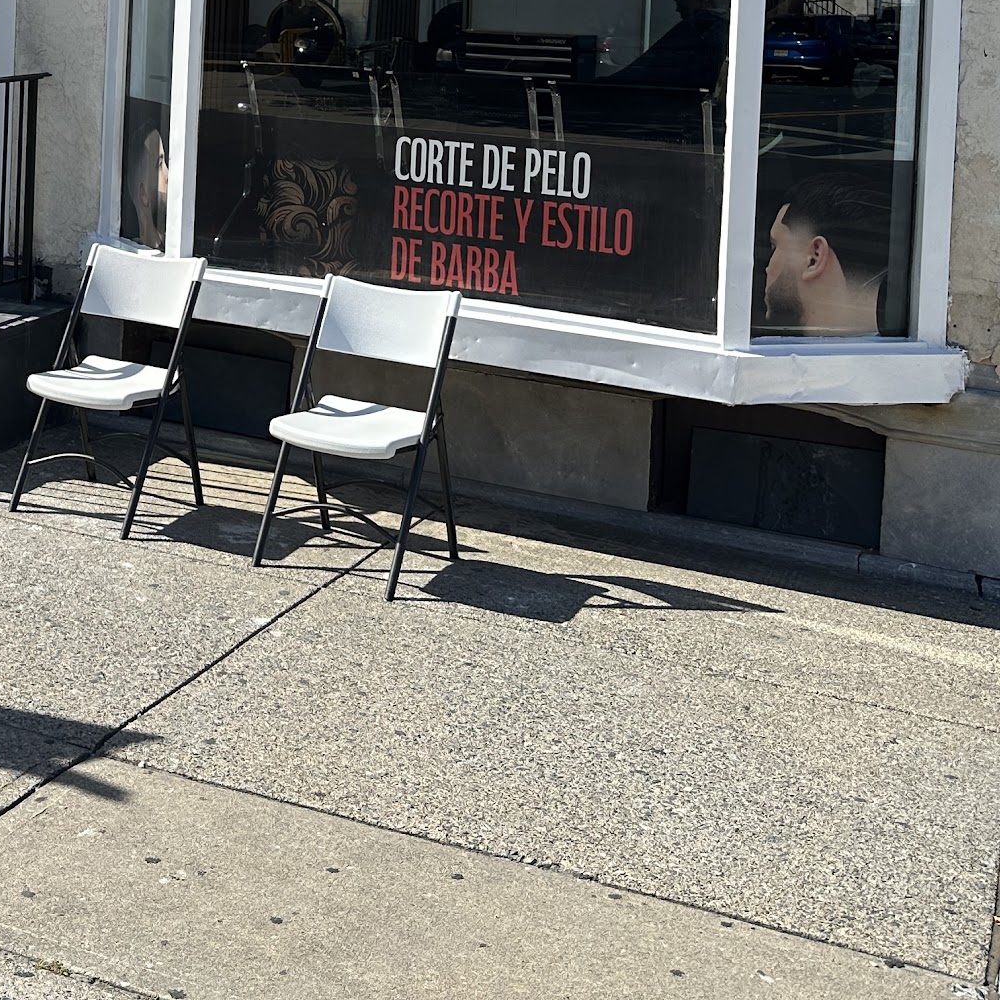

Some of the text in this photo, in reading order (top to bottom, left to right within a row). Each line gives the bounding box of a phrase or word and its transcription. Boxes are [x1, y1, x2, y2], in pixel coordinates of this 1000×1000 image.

[394, 136, 592, 200] CORTE DE PELO
[392, 185, 634, 257] RECORTE Y ESTILO
[390, 236, 520, 296] DE BARBA
